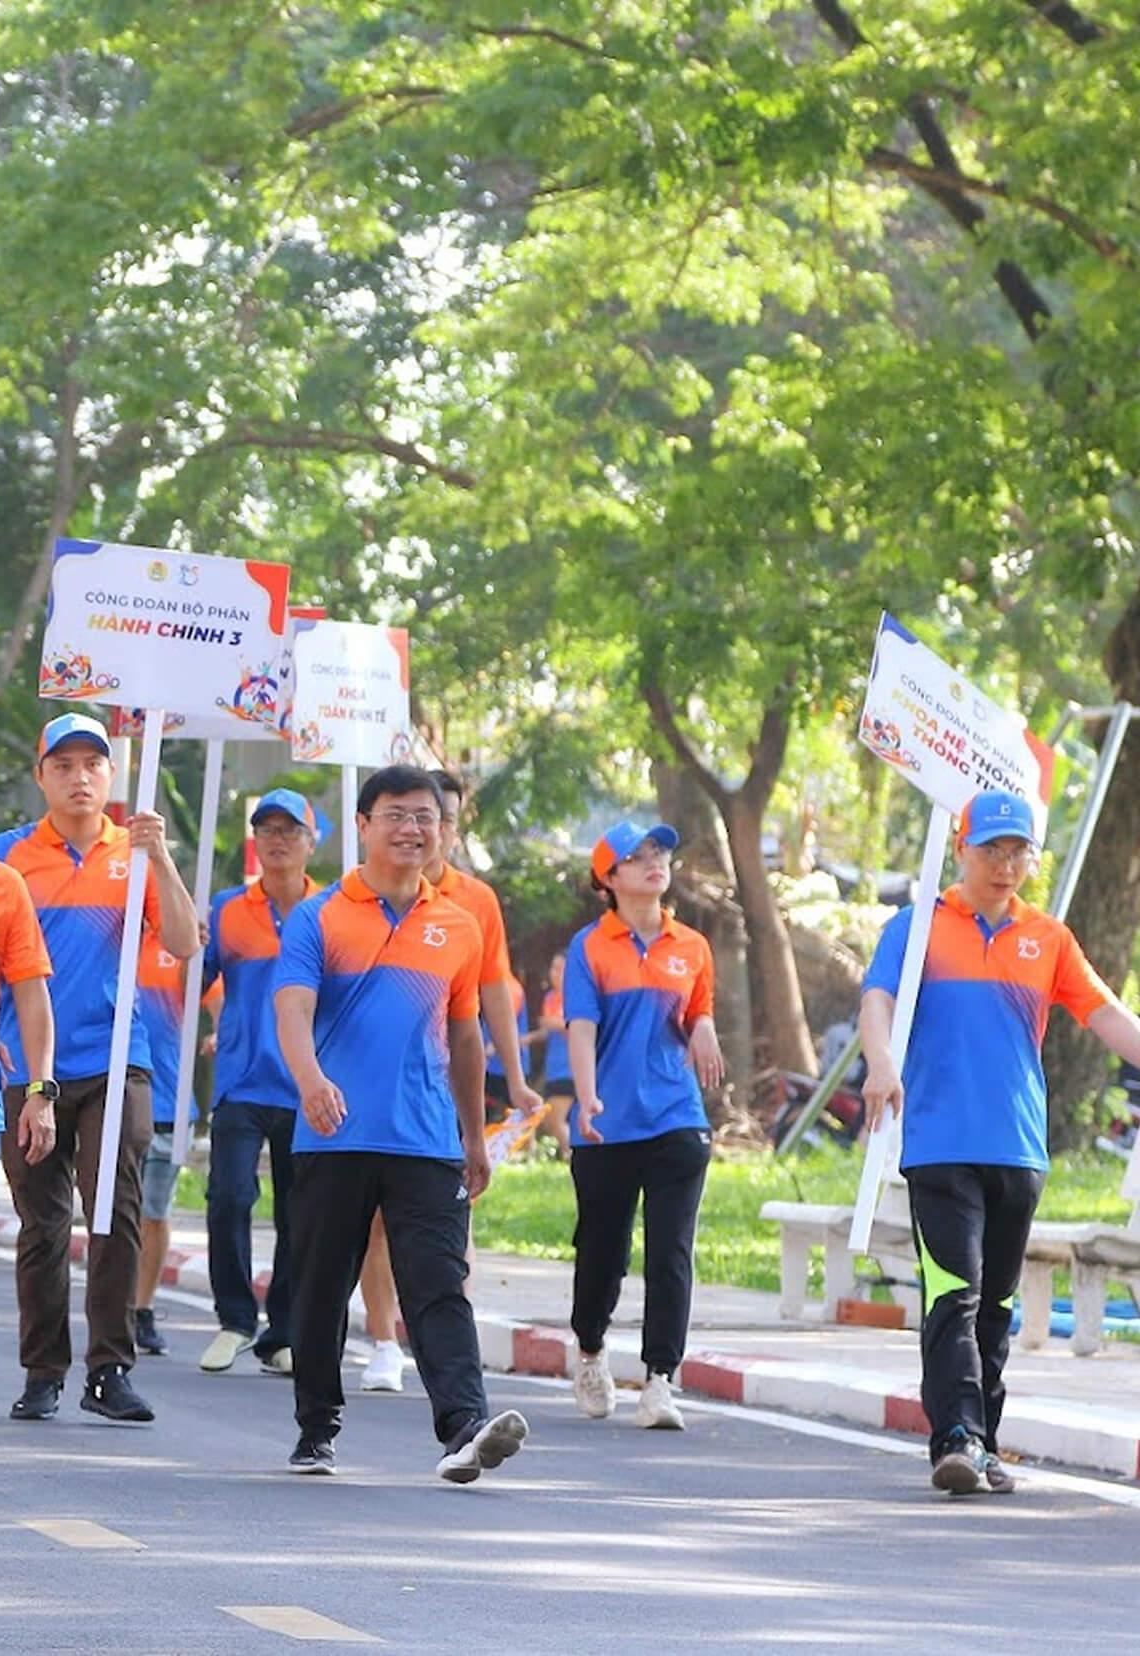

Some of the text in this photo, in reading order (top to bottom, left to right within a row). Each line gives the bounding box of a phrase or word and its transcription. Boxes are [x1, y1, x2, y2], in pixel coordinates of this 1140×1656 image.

[84, 588, 129, 607] CÔNG
[132, 595, 178, 612] ĐOÀN
[87, 612, 243, 646] HÀNH CHÍNH 3
